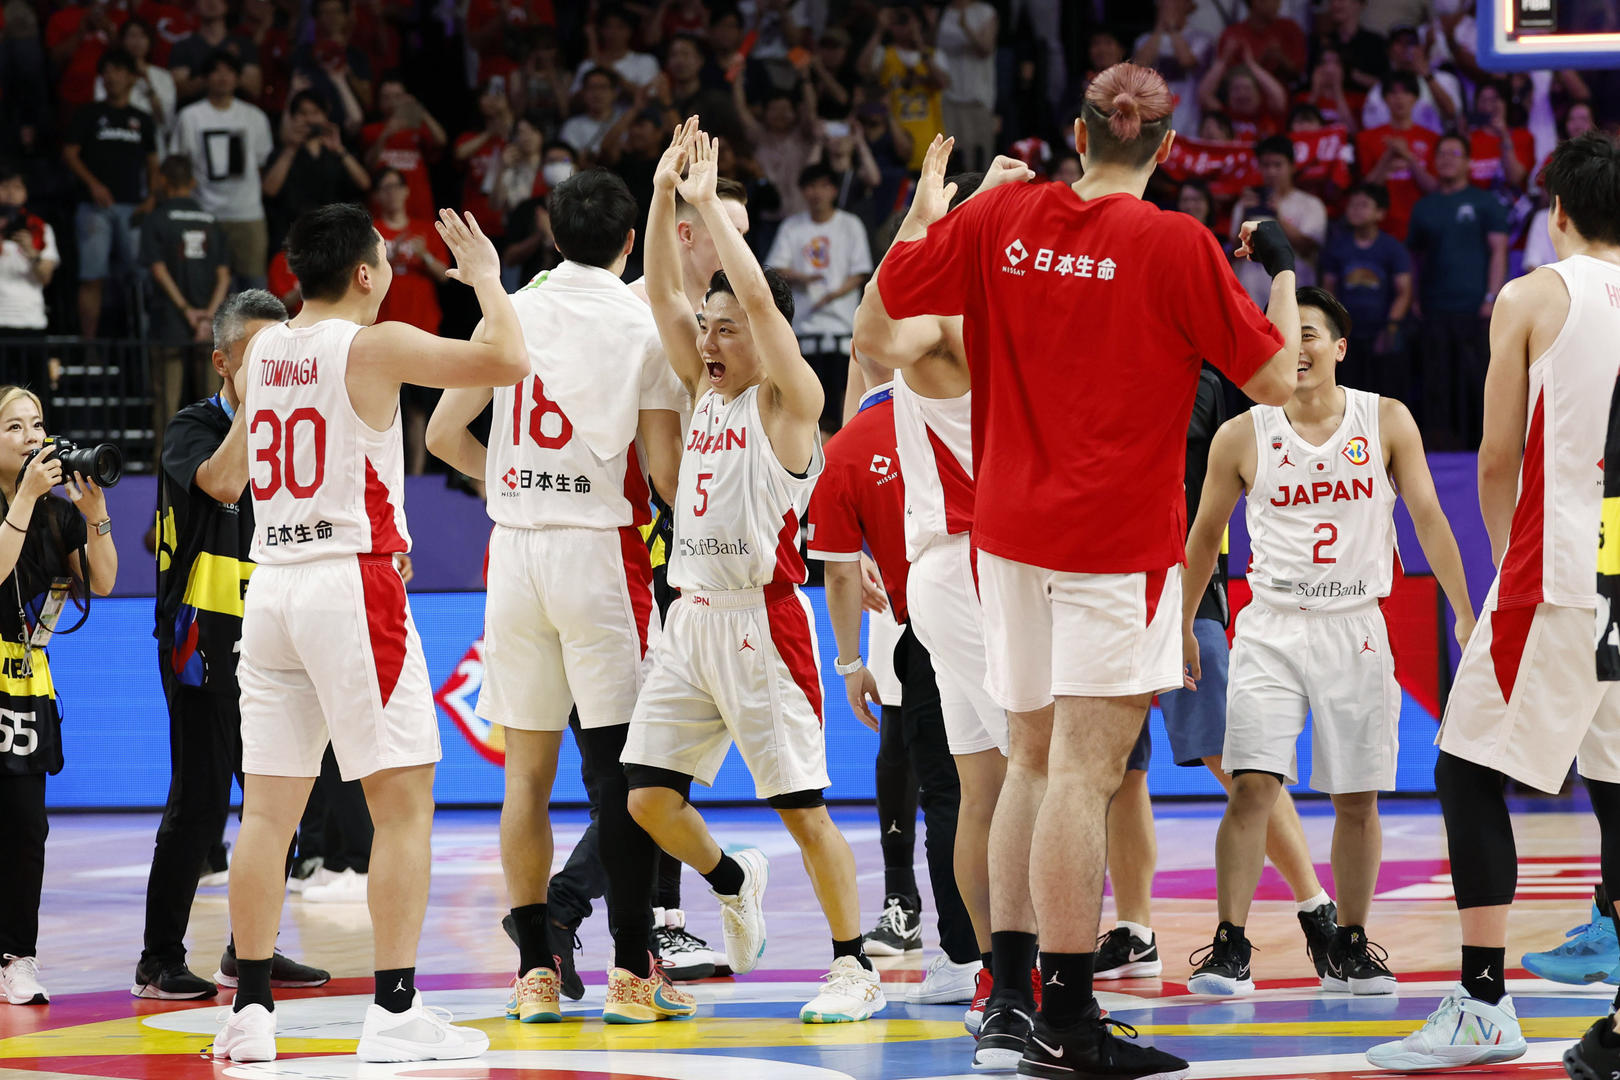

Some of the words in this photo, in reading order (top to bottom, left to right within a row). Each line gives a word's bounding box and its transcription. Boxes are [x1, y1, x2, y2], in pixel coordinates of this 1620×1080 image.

[1002, 265, 1026, 277] NISSAY
[1034, 248, 1117, 281] 日本生命
[687, 427, 746, 454] JAPAN
[250, 407, 327, 502] 30
[520, 469, 592, 494] 日本生命
[876, 471, 898, 486] NISSAY
[693, 473, 713, 517] 5
[1270, 477, 1374, 507] JAPAN
[266, 520, 333, 546] 日本生命
[1312, 522, 1338, 563] 2
[686, 538, 750, 556] SoftBank
[693, 595, 710, 606] JPN
[1295, 579, 1368, 598] SoftBank
